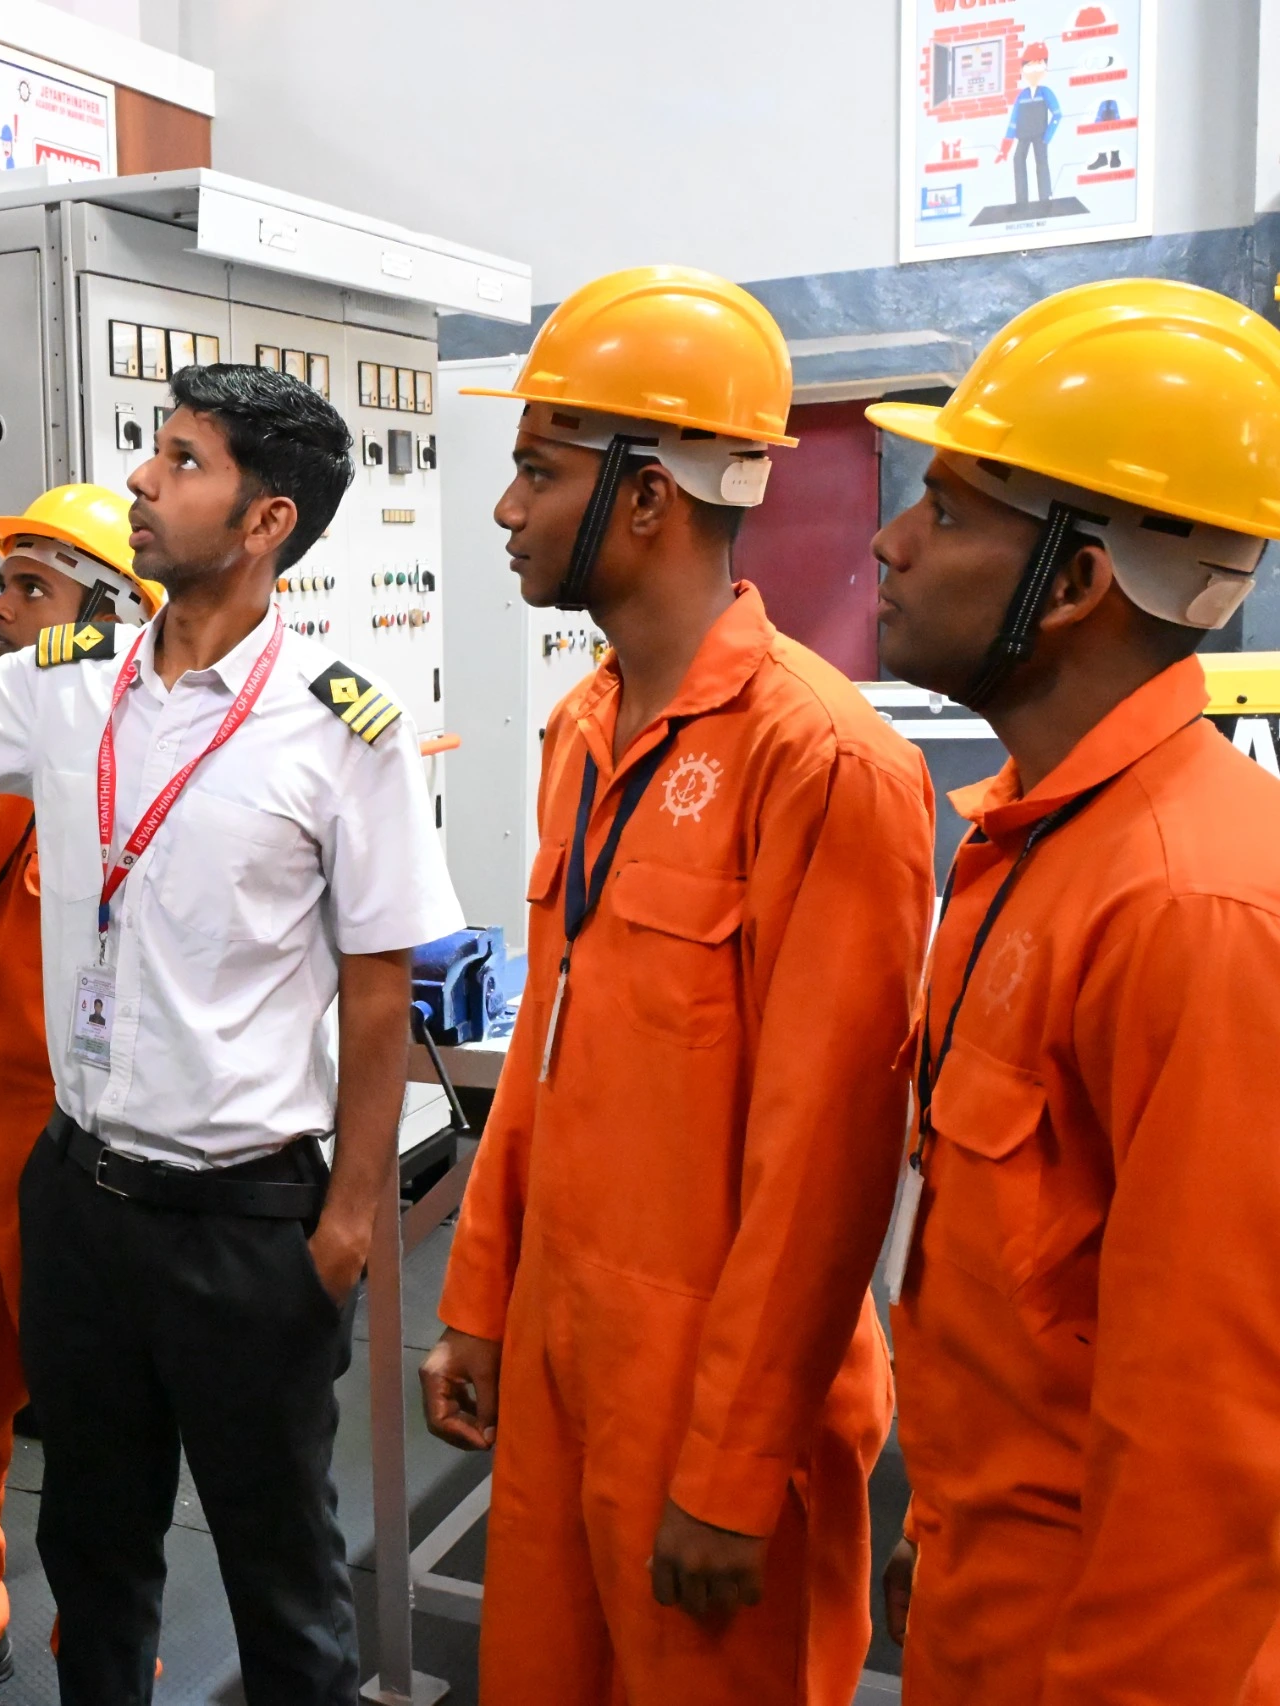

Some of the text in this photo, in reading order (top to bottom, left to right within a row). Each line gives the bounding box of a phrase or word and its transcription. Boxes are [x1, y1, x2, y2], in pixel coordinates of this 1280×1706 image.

[236, 697, 248, 713] OF
[246, 656, 272, 698] MARINE
[100, 734, 111, 839] JEYANTHINATHER
[134, 759, 197, 851] JEYANTHINATHER
